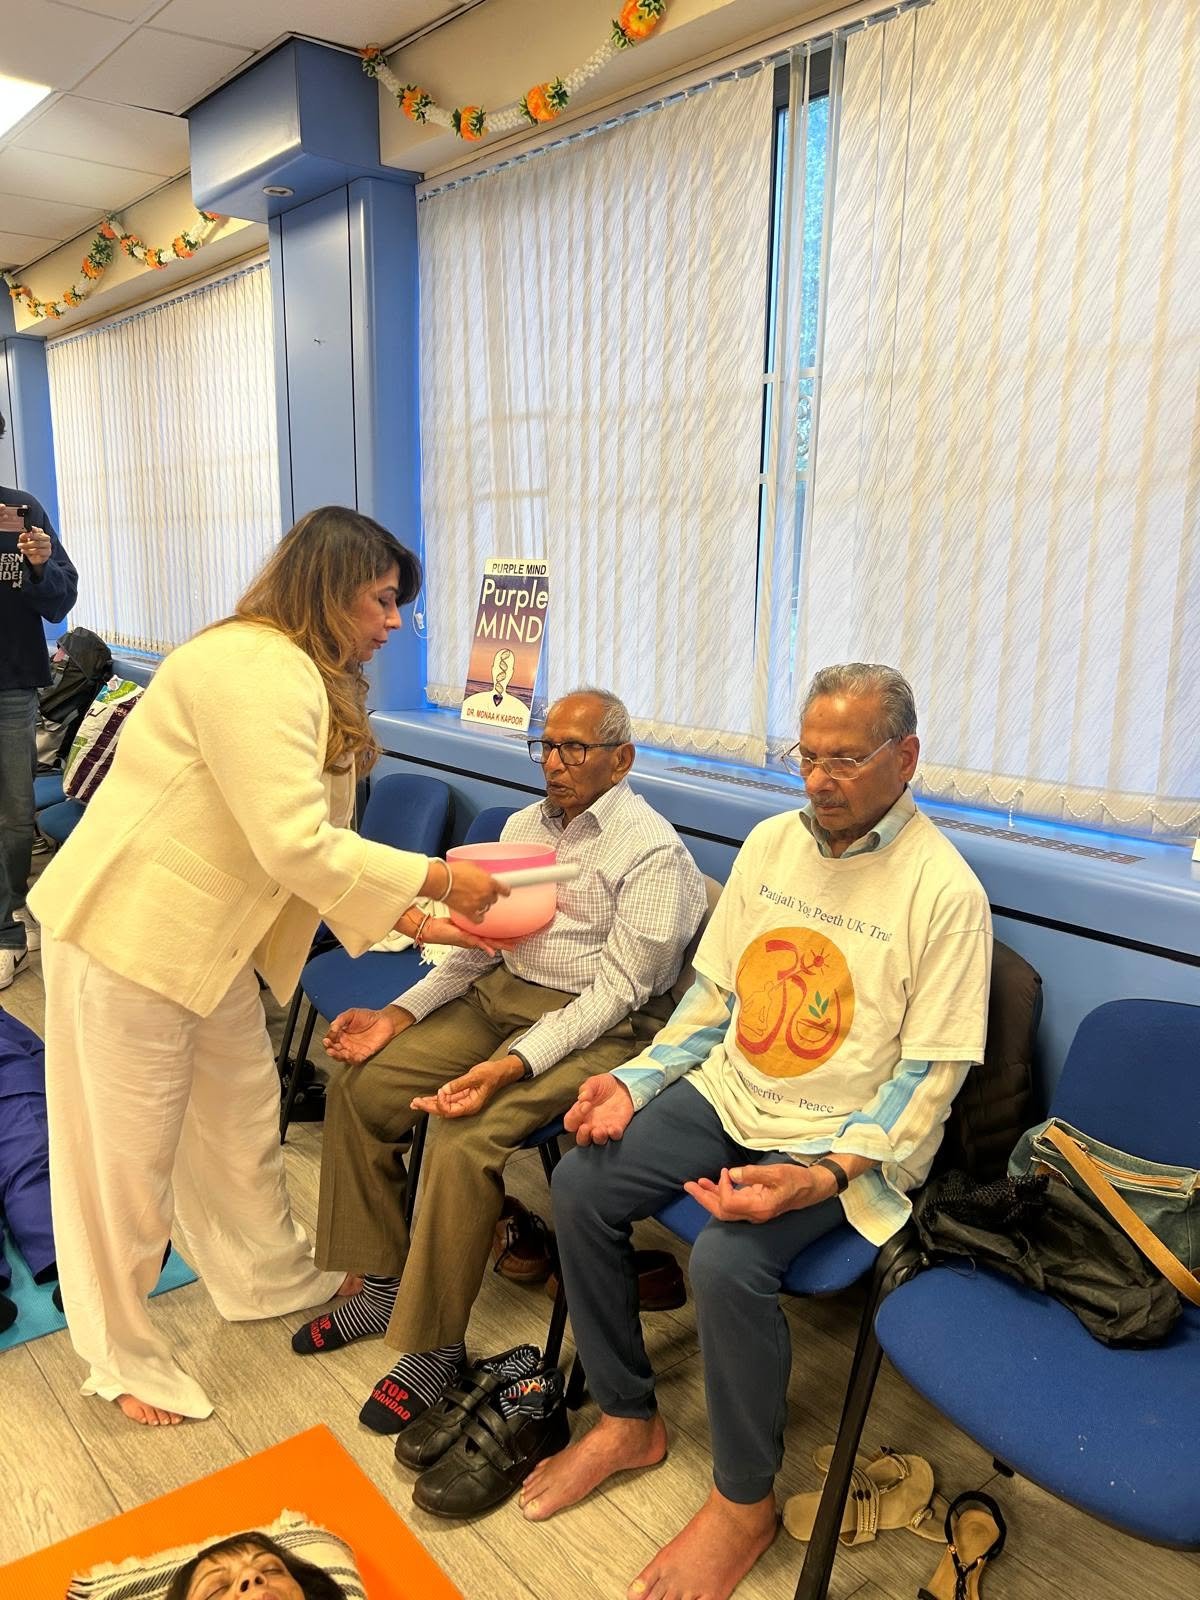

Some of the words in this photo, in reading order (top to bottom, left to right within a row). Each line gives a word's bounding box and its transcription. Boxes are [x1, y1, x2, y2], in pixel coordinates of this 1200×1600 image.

[492, 563, 524, 574] PURPLE
[526, 564, 546, 575] MIND
[481, 578, 549, 615] Purple
[476, 611, 543, 643] MIND
[501, 715, 523, 726] KAPOOR
[812, 907, 844, 927] Peeth
[847, 918, 866, 933] UK
[799, 1098, 834, 1113] Peace
[381, 1379, 409, 1402] TOP
